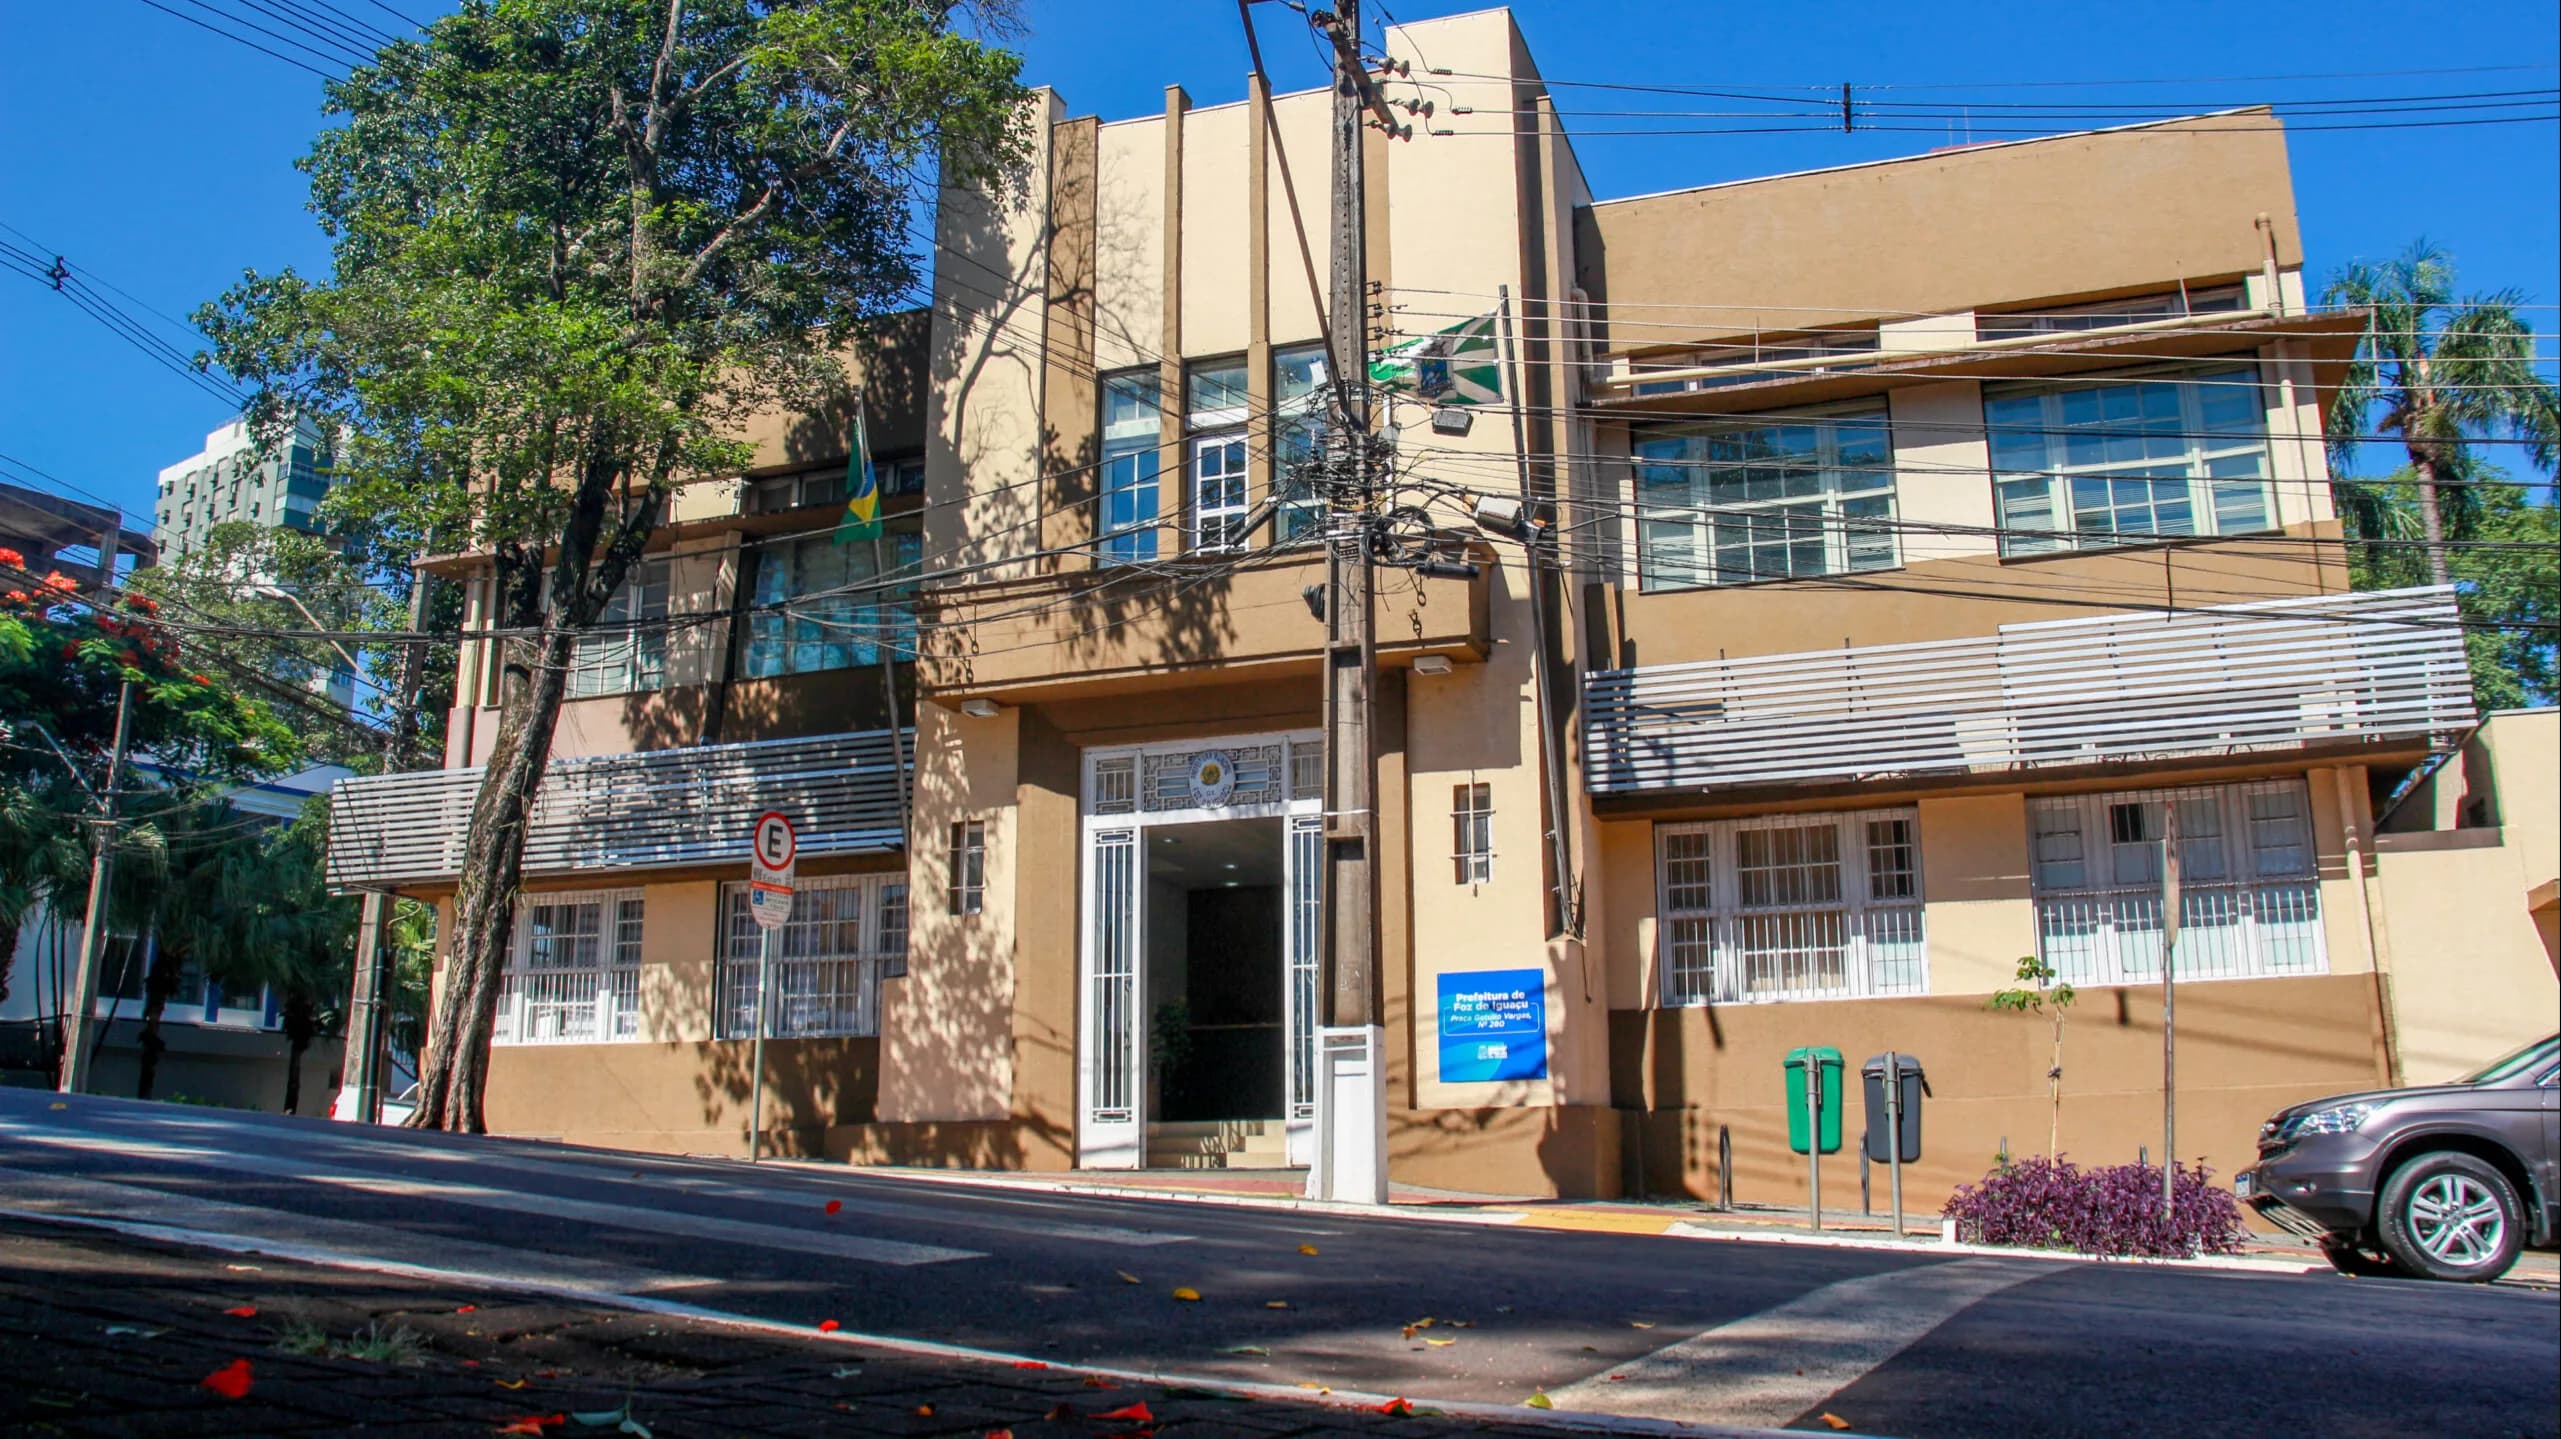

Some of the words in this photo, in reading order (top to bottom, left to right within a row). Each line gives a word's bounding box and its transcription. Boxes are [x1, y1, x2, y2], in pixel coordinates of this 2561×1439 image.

[767, 824, 783, 859] E
[1456, 992, 1509, 1002] Prefeitura
[1511, 989, 1525, 999] de
[1453, 1003, 1472, 1012] Foz
[1492, 1000, 1529, 1011] Iguaçu
